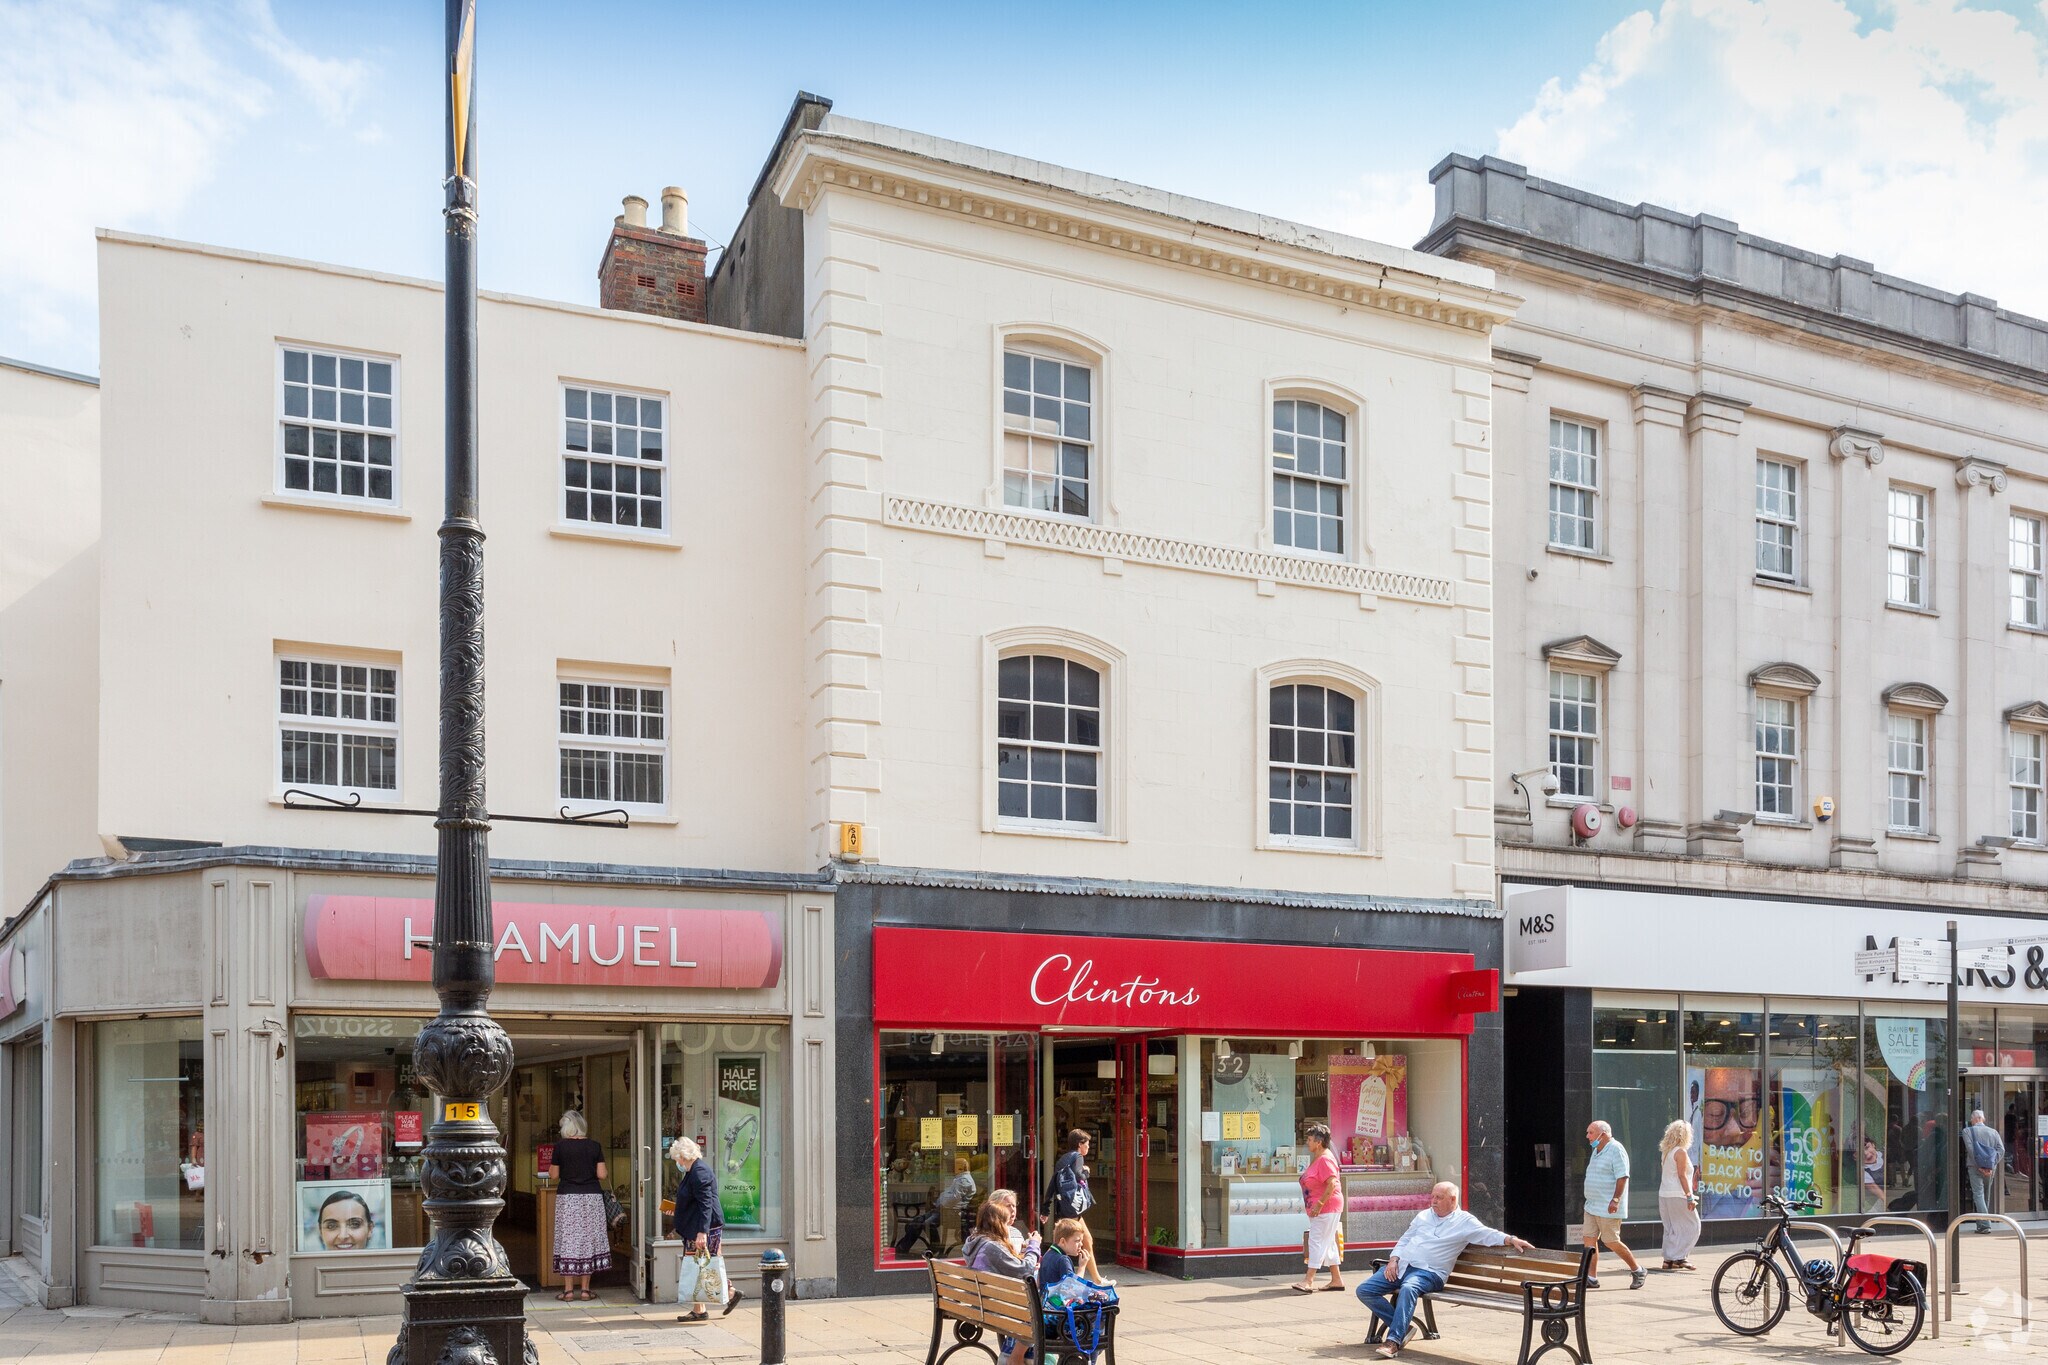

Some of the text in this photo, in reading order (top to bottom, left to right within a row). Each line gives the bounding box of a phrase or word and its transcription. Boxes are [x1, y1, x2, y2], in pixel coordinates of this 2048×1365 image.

[1519, 913, 1555, 937] M&S
[493, 921, 697, 968] AMUEL
[1030, 953, 1200, 1008] Clintons
[1888, 1033, 1919, 1047] SALE
[1233, 1057, 1243, 1073] 2
[723, 1068, 756, 1080] HALF
[722, 1080, 757, 1091] PRICE
[1709, 1144, 1743, 1160] BACK
[1748, 1149, 1763, 1162] TO
[1708, 1163, 1742, 1179] BACK
[1747, 1167, 1762, 1180] TO
[1698, 1181, 1732, 1197] BACK
[1737, 1185, 1753, 1198] TO
